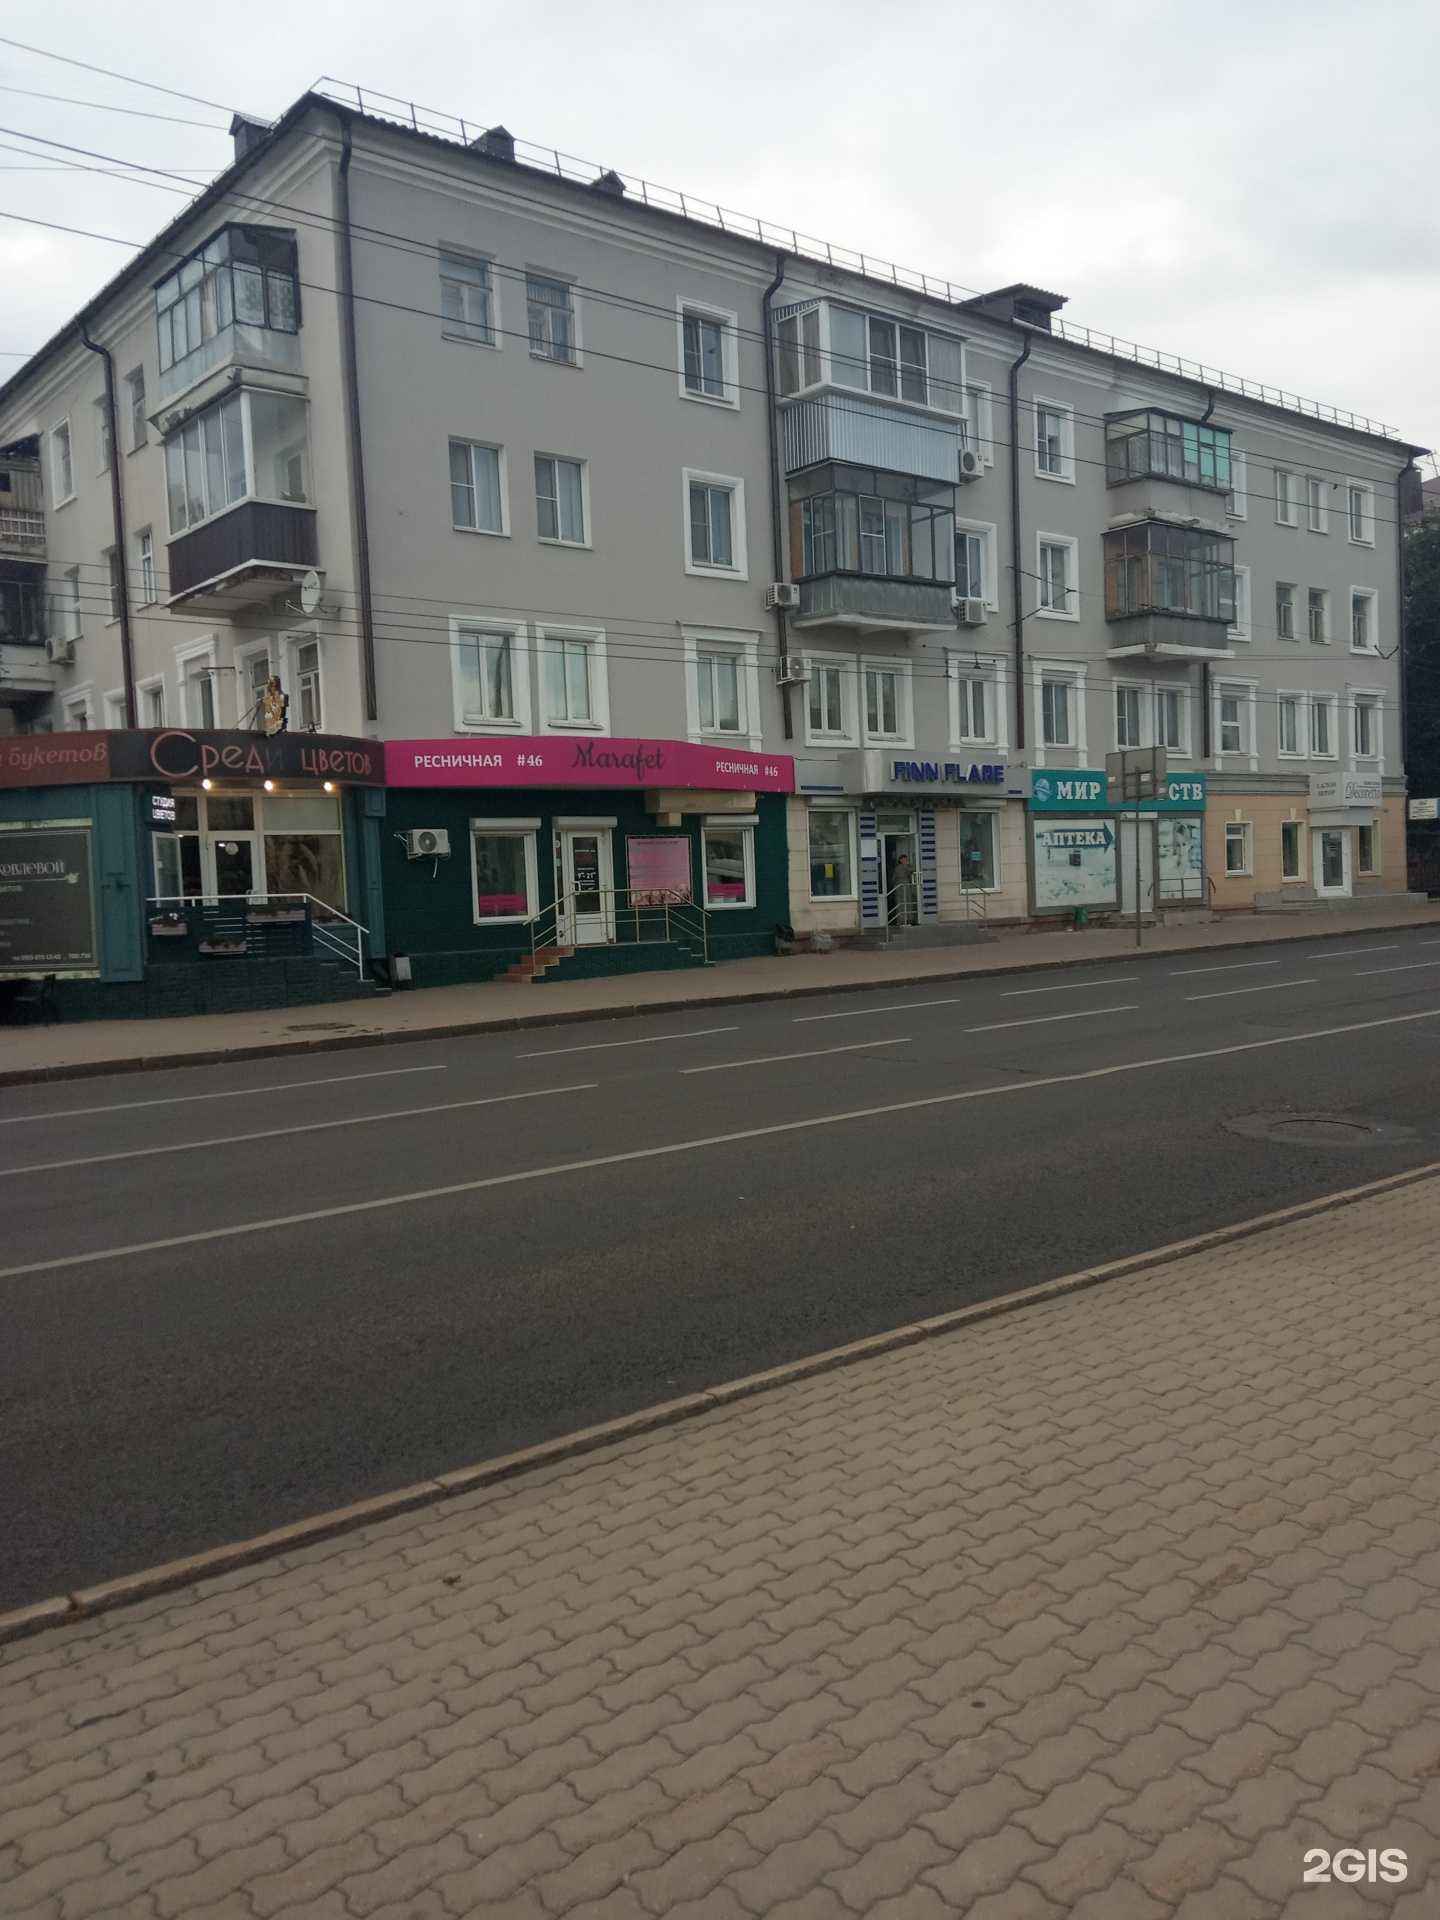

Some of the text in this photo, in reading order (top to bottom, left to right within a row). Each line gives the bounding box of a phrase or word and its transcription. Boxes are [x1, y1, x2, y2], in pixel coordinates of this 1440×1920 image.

[414, 754, 543, 768] РЕСНИЧНАЯ #46
[571, 740, 667, 783] Marafet
[715, 761, 779, 777] РЕСНИЧНАЯ #46
[1057, 781, 1101, 800] МИР
[1041, 831, 1107, 847] АПТЕКА
